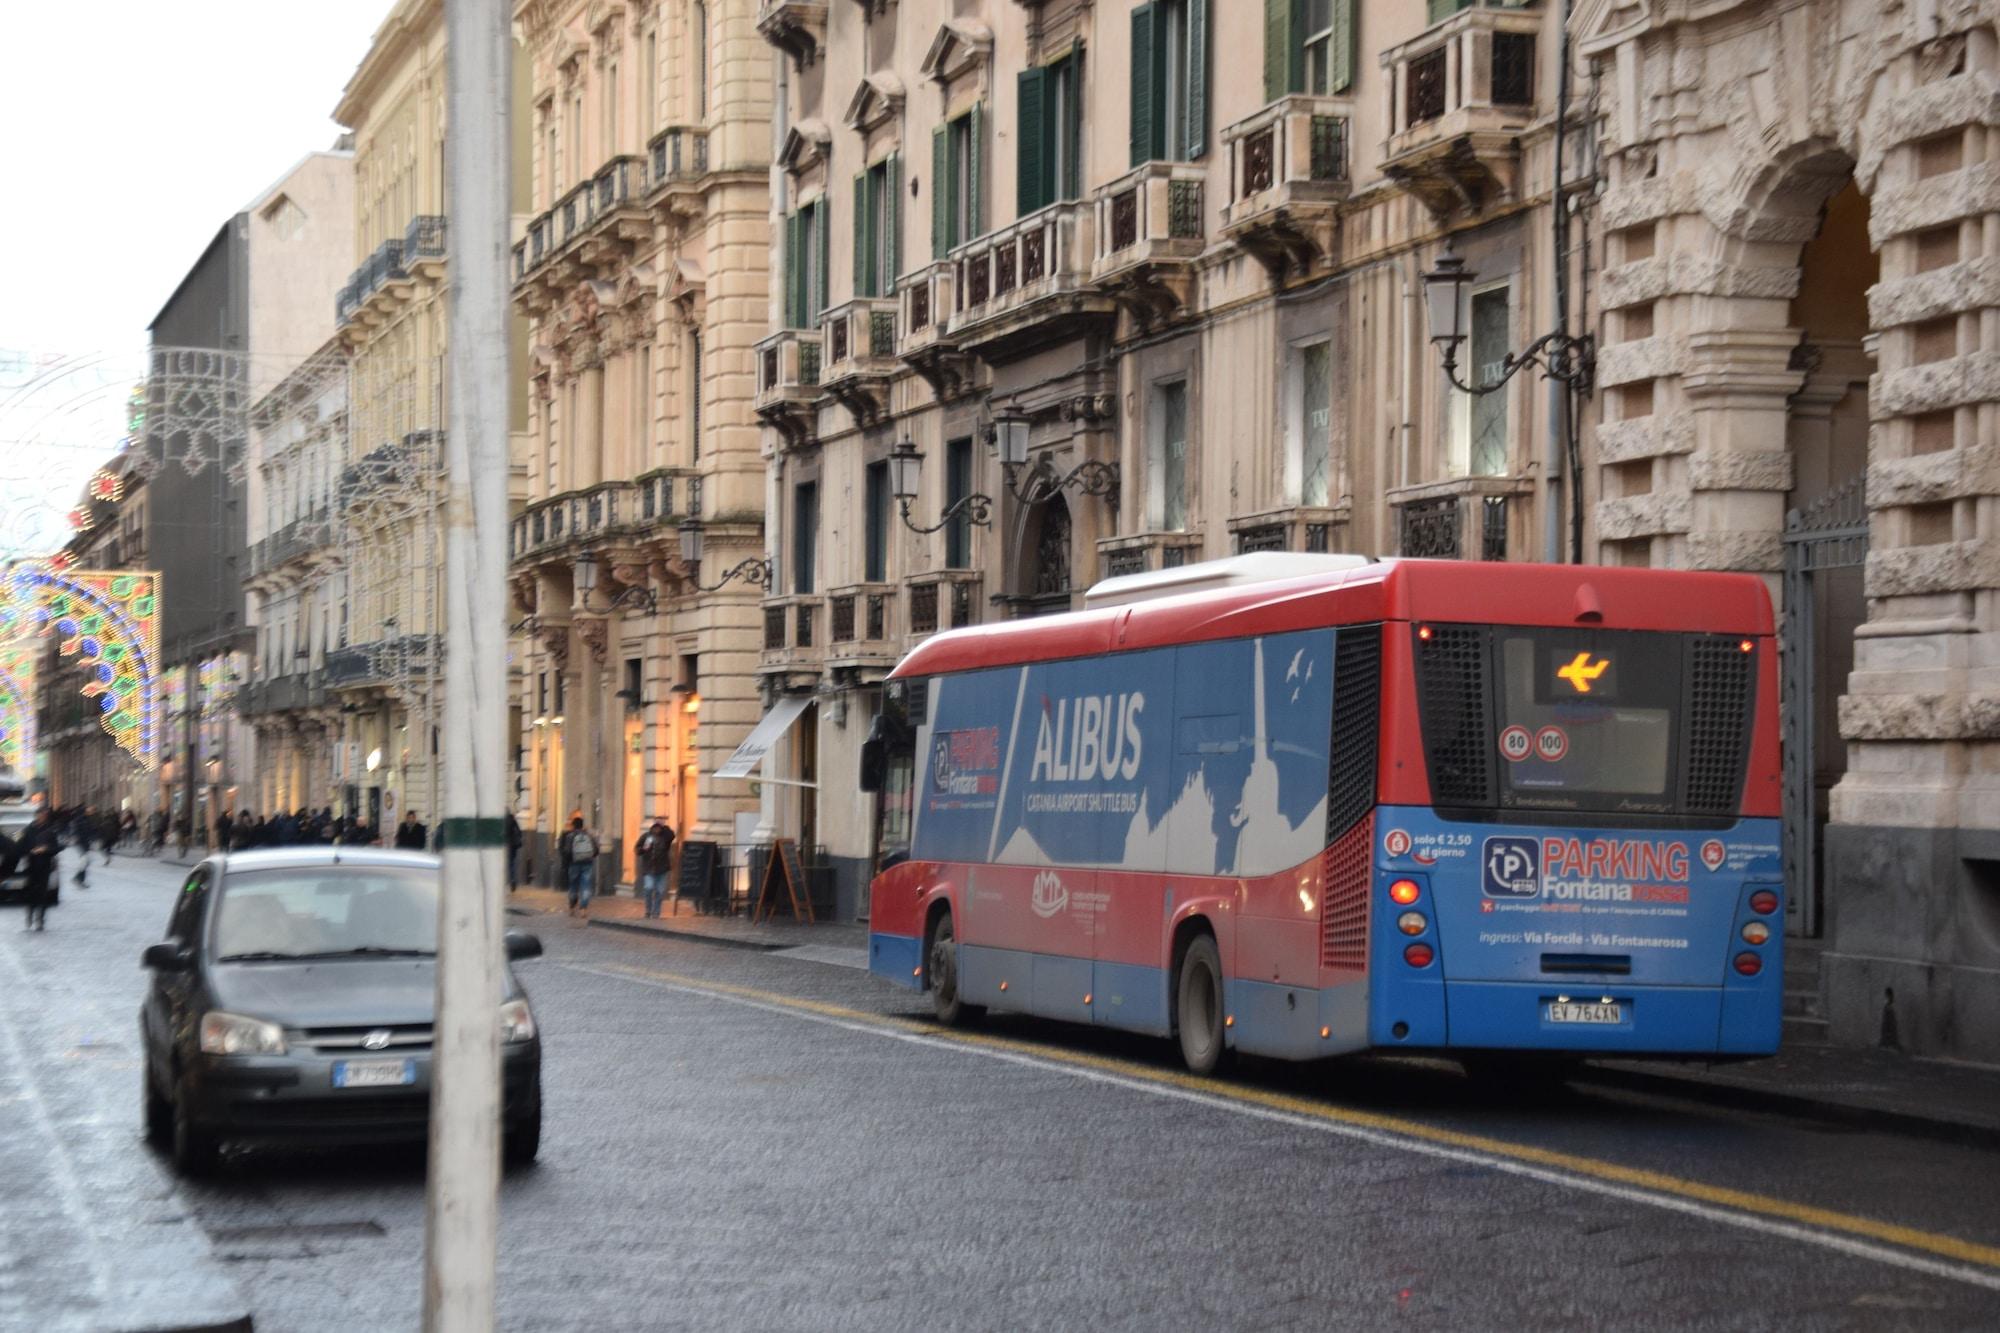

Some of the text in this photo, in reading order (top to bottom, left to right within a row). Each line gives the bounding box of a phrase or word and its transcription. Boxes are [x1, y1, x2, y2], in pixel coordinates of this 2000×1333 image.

[1030, 691, 1144, 782] ALIBUS
[1508, 735, 1525, 749] 80
[1541, 735, 1561, 749] 100
[1027, 792, 1137, 813] CATANIA AIRPORT SHUTTLE BUS
[1414, 834, 1436, 845] solo
[1431, 847, 1466, 859] giorno
[1541, 836, 1689, 882] PARKING
[1524, 932, 1542, 943] Via
[1591, 934, 1609, 946] Via
[1611, 934, 1689, 949] Fontanarossa
